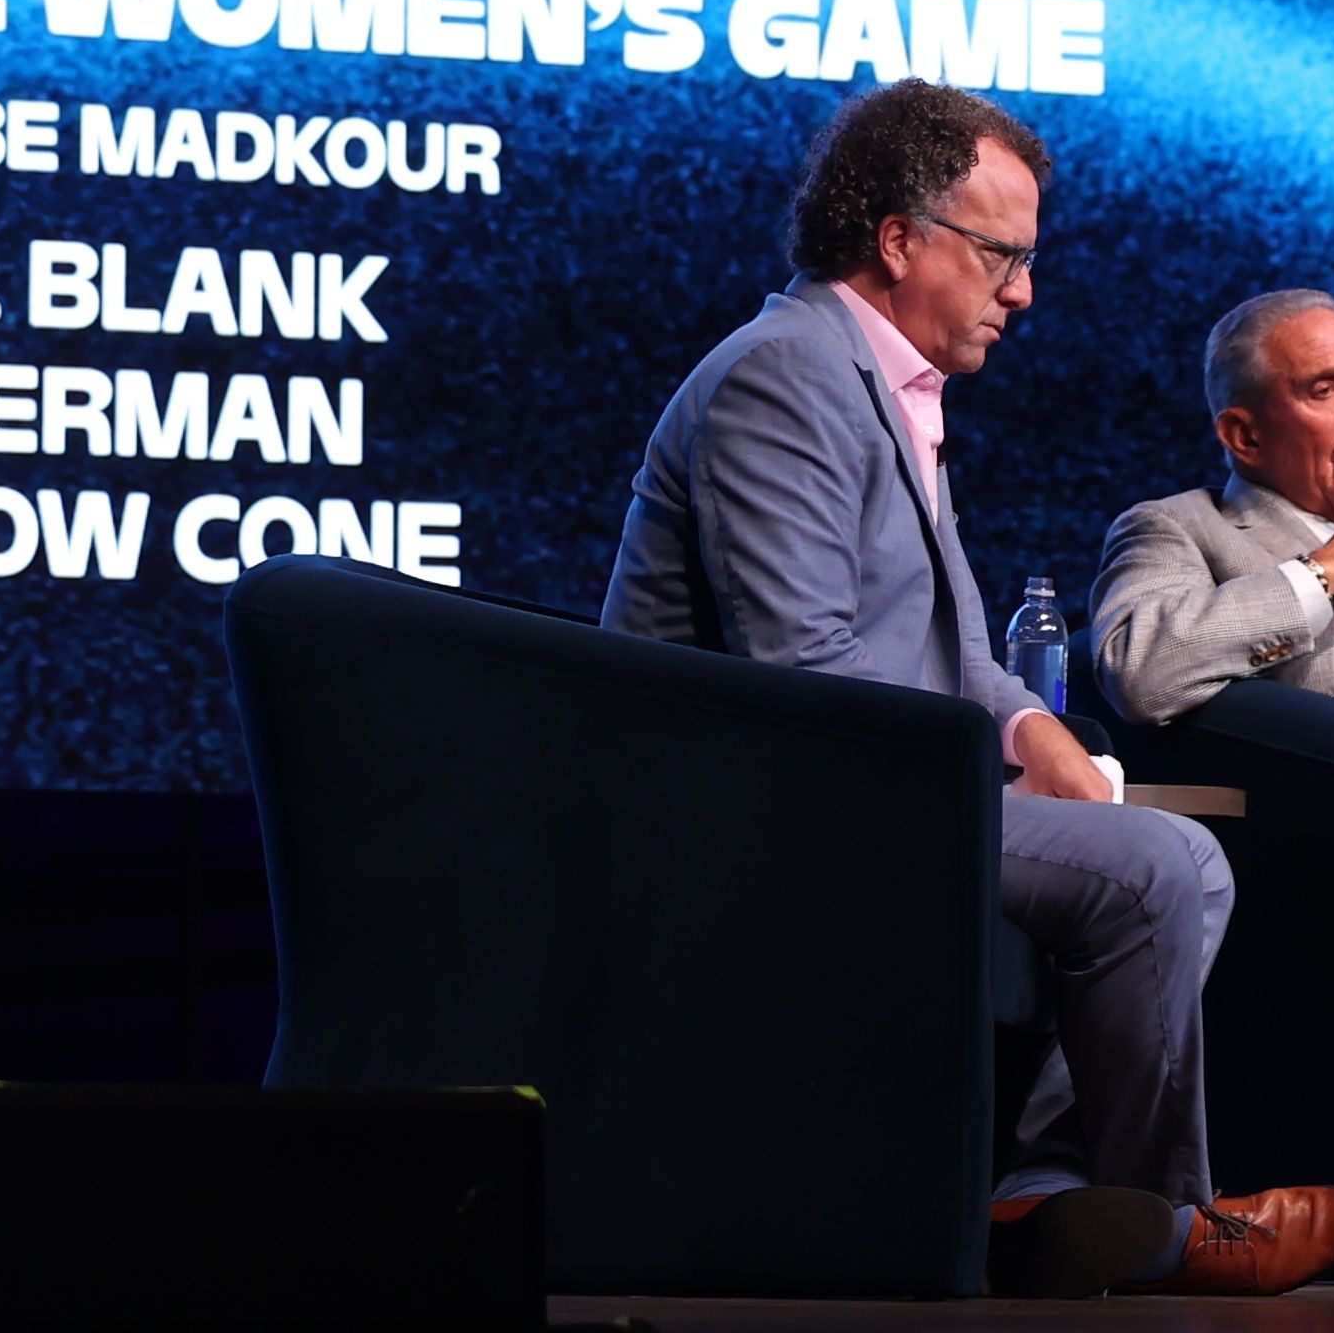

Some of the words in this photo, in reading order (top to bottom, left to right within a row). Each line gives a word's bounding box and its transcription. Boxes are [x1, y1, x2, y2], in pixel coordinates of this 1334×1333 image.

[82, 106, 500, 193] MADKOUR
[30, 241, 388, 341] BLANK
[175, 496, 461, 587] CONE
